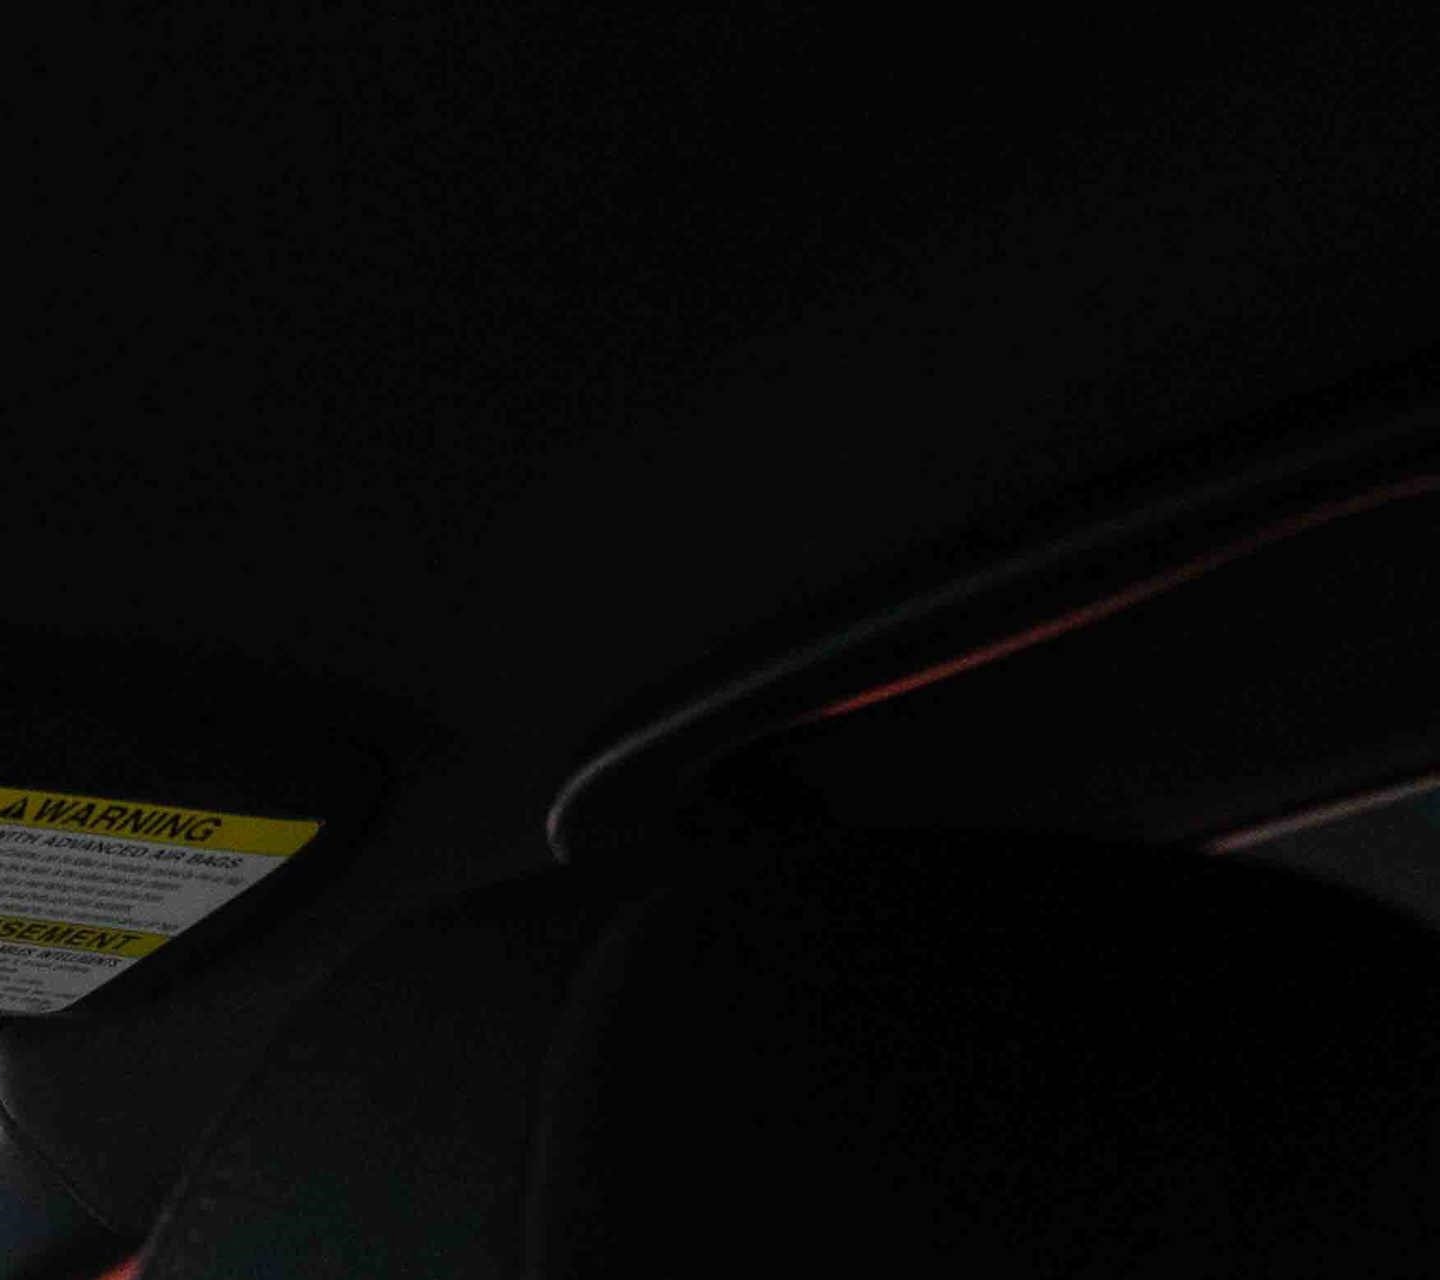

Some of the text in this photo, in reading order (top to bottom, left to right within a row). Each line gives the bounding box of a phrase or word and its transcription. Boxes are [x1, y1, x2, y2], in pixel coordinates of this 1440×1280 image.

[33, 799, 222, 842] WARNING
[45, 834, 149, 860] ADVANCED
[150, 847, 186, 863] AIR
[190, 853, 245, 870] BAGS
